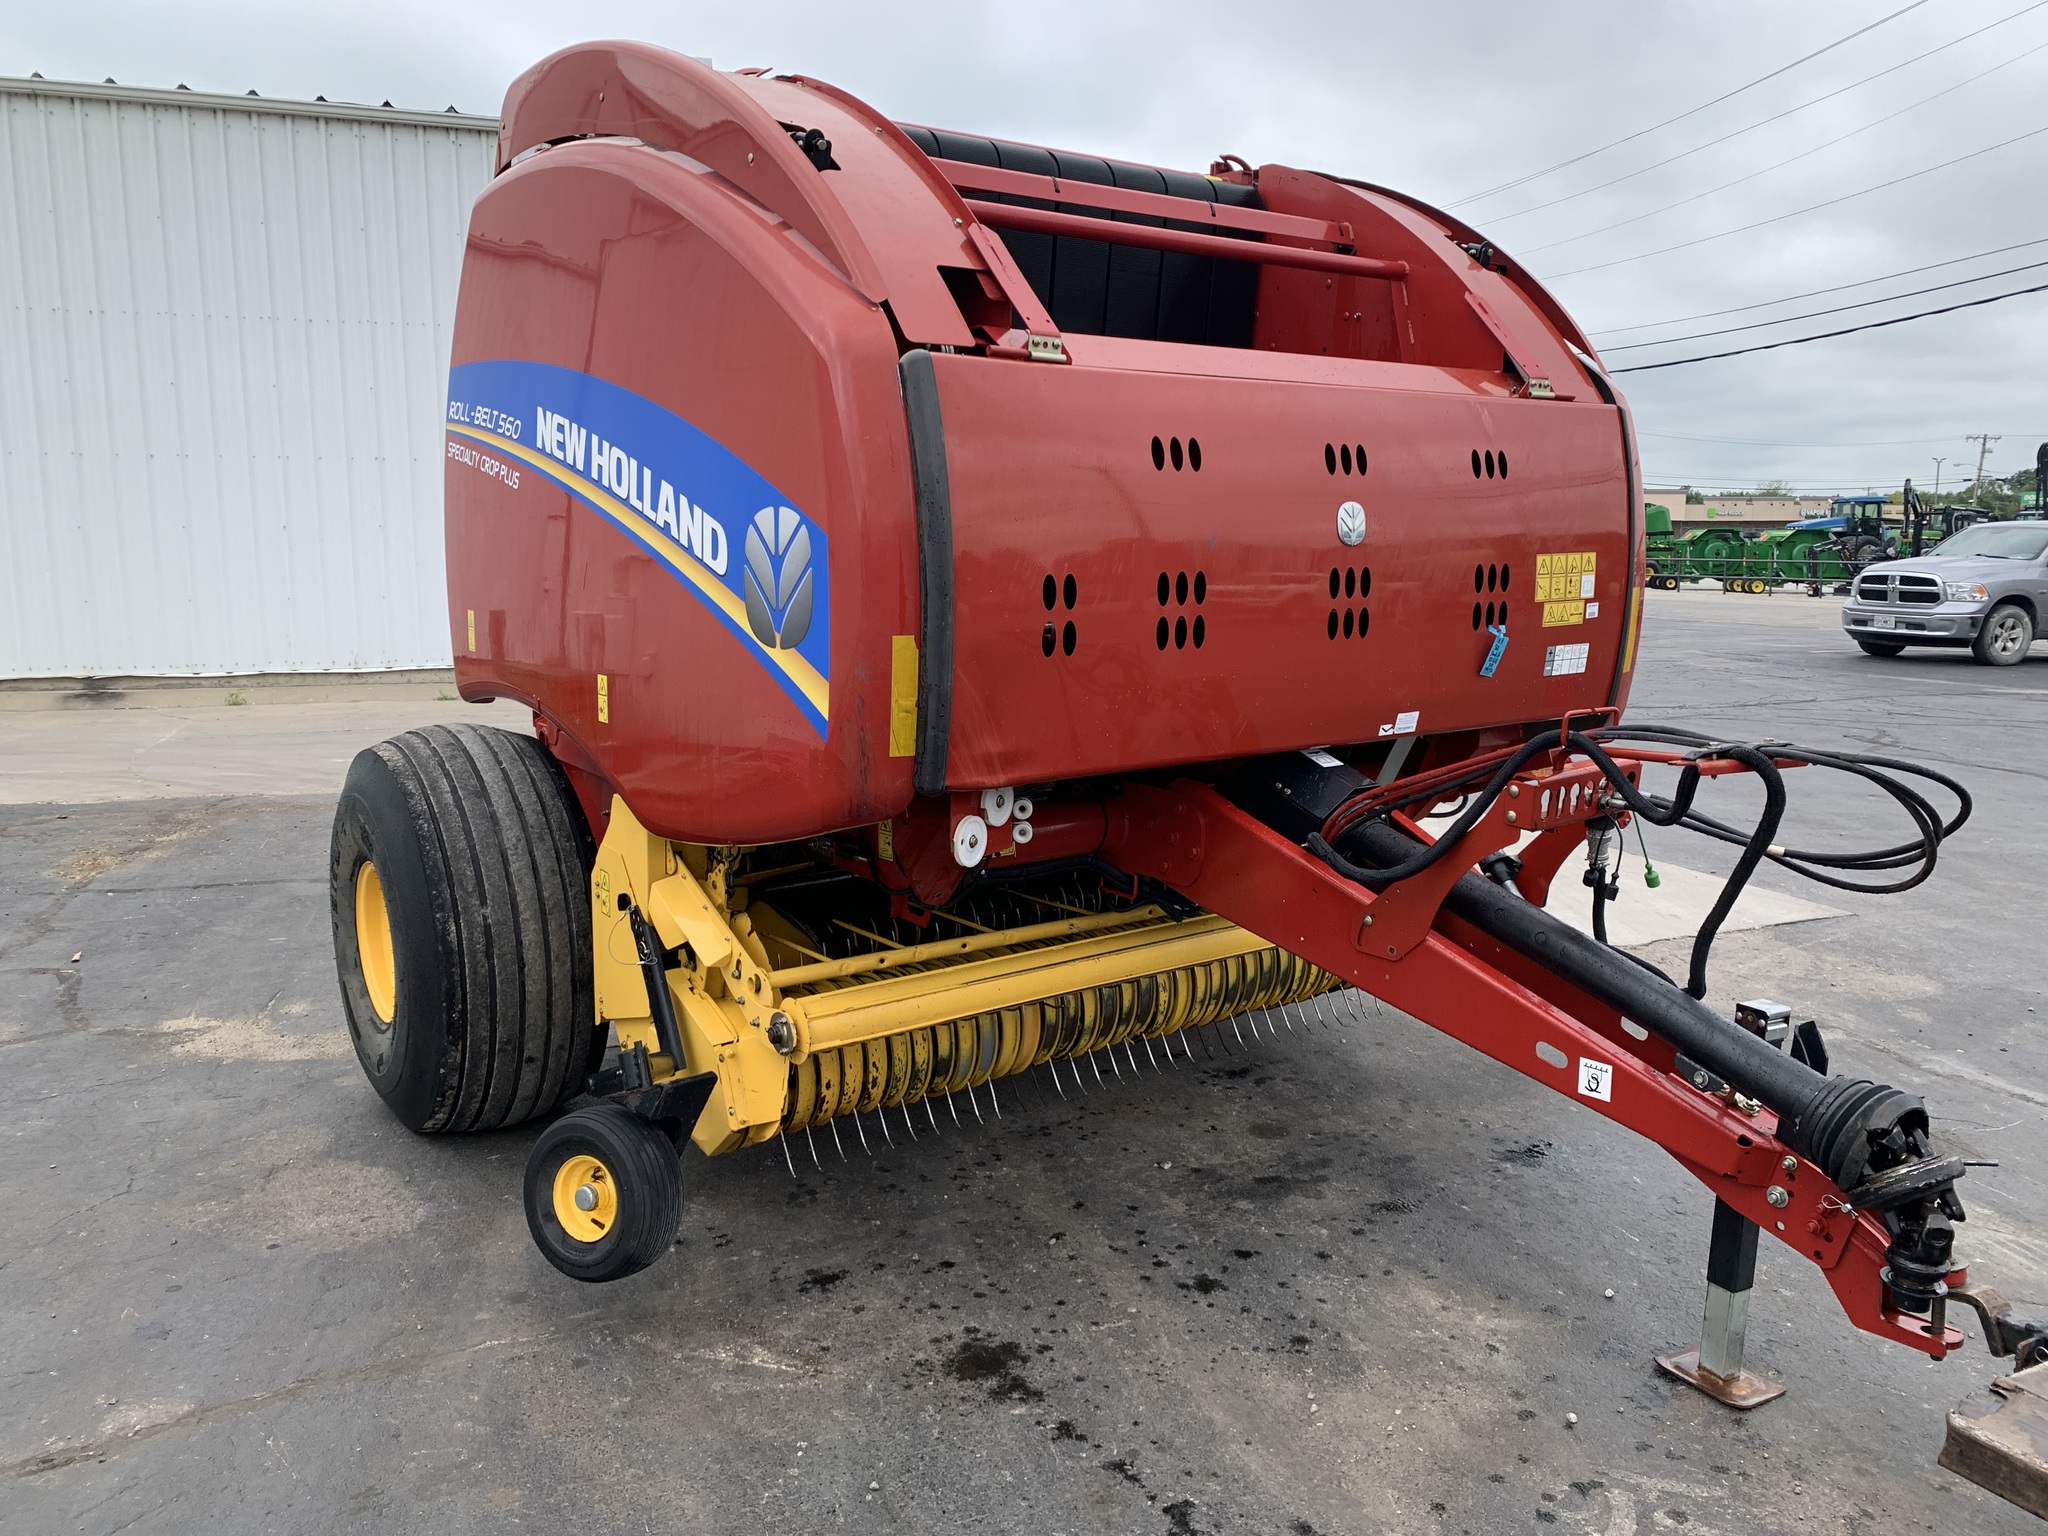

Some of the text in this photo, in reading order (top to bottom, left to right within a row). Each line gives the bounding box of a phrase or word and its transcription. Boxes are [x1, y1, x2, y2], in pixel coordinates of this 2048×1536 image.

[497, 413, 521, 439] 560
[447, 442, 520, 489] SPECIALTY CROP PLUS
[536, 406, 728, 576] NEW HOLLAND
